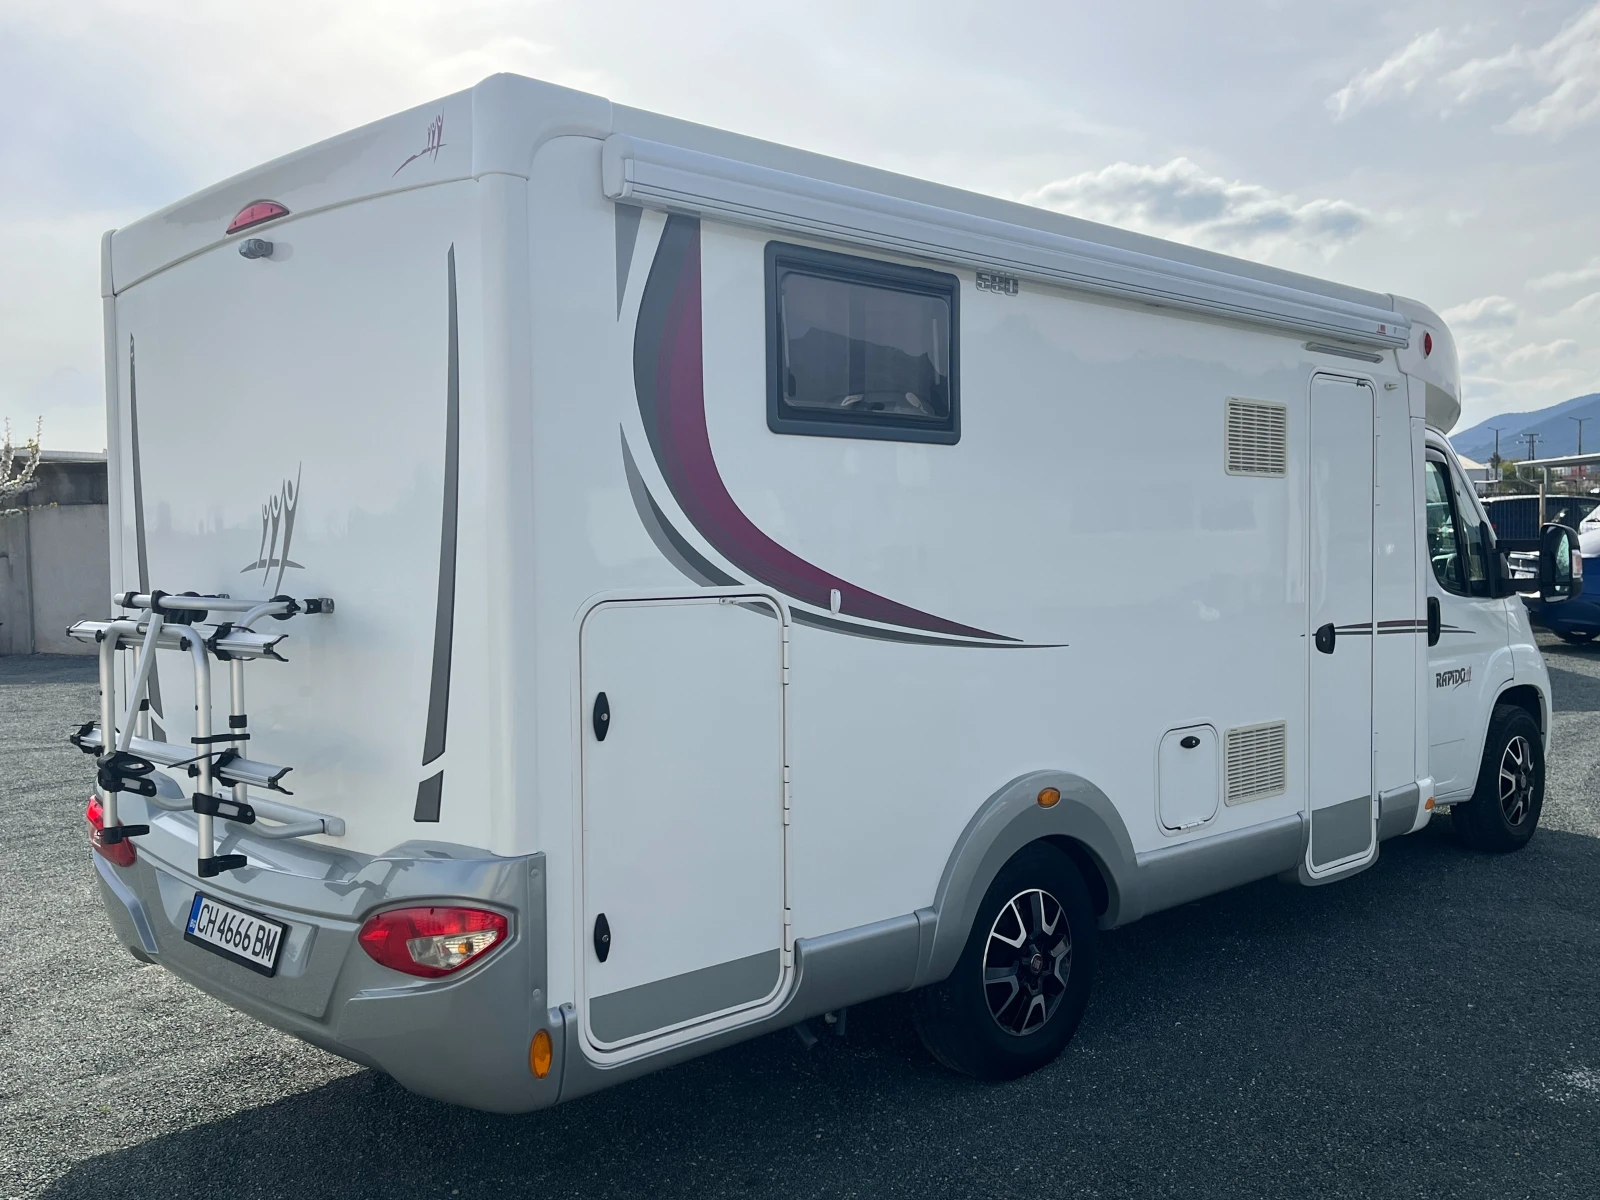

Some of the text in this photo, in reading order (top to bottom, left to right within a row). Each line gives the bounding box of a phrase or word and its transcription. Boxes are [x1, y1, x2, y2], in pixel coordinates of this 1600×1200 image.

[1436, 668, 1465, 688] RAPIDO
[217, 912, 253, 951] 4666
[252, 924, 278, 962] BM
